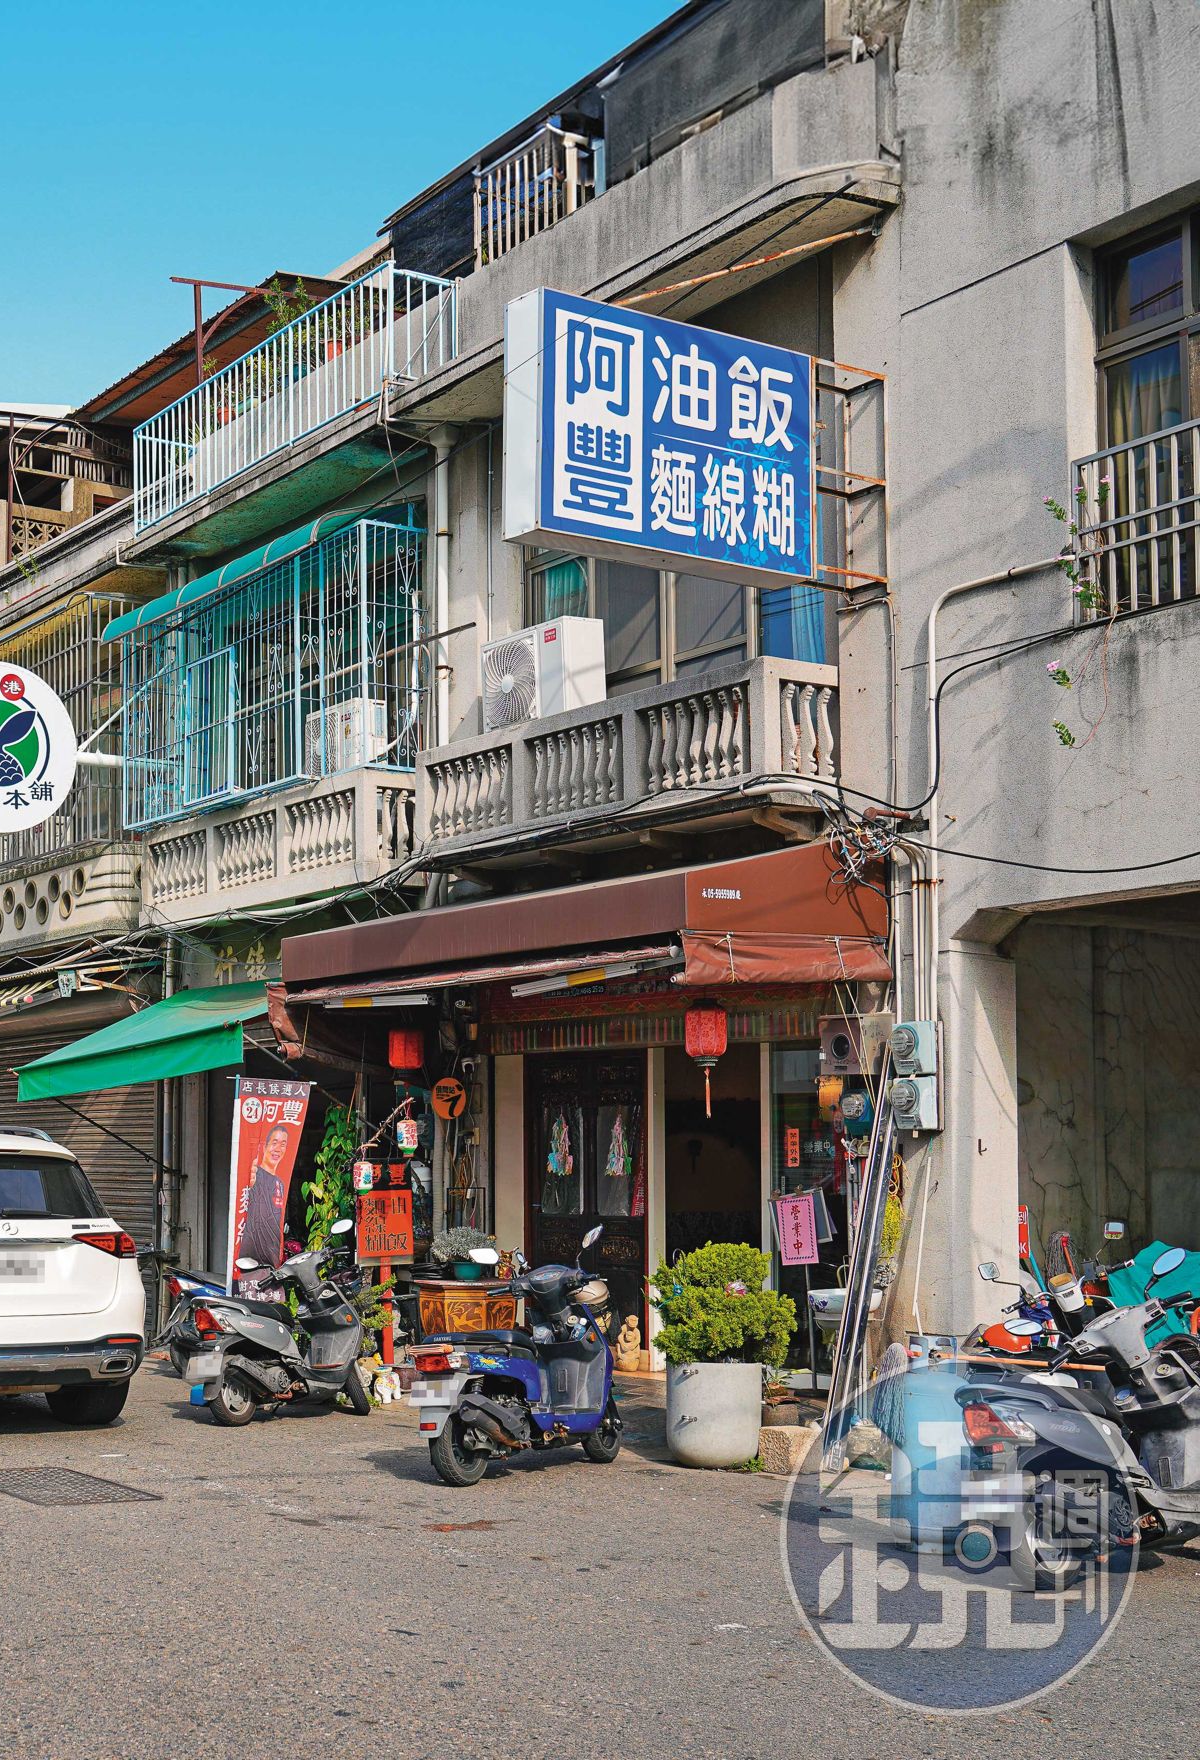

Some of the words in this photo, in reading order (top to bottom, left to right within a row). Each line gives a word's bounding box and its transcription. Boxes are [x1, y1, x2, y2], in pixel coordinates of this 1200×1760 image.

[563, 318, 635, 520] 阿豐
[652, 335, 794, 452] 油飯
[650, 443, 794, 557] 麵線糊
[242, 1080, 306, 1097] 店長候選人
[262, 1099, 304, 1126] 阿豐
[790, 1204, 803, 1256] 營業中
